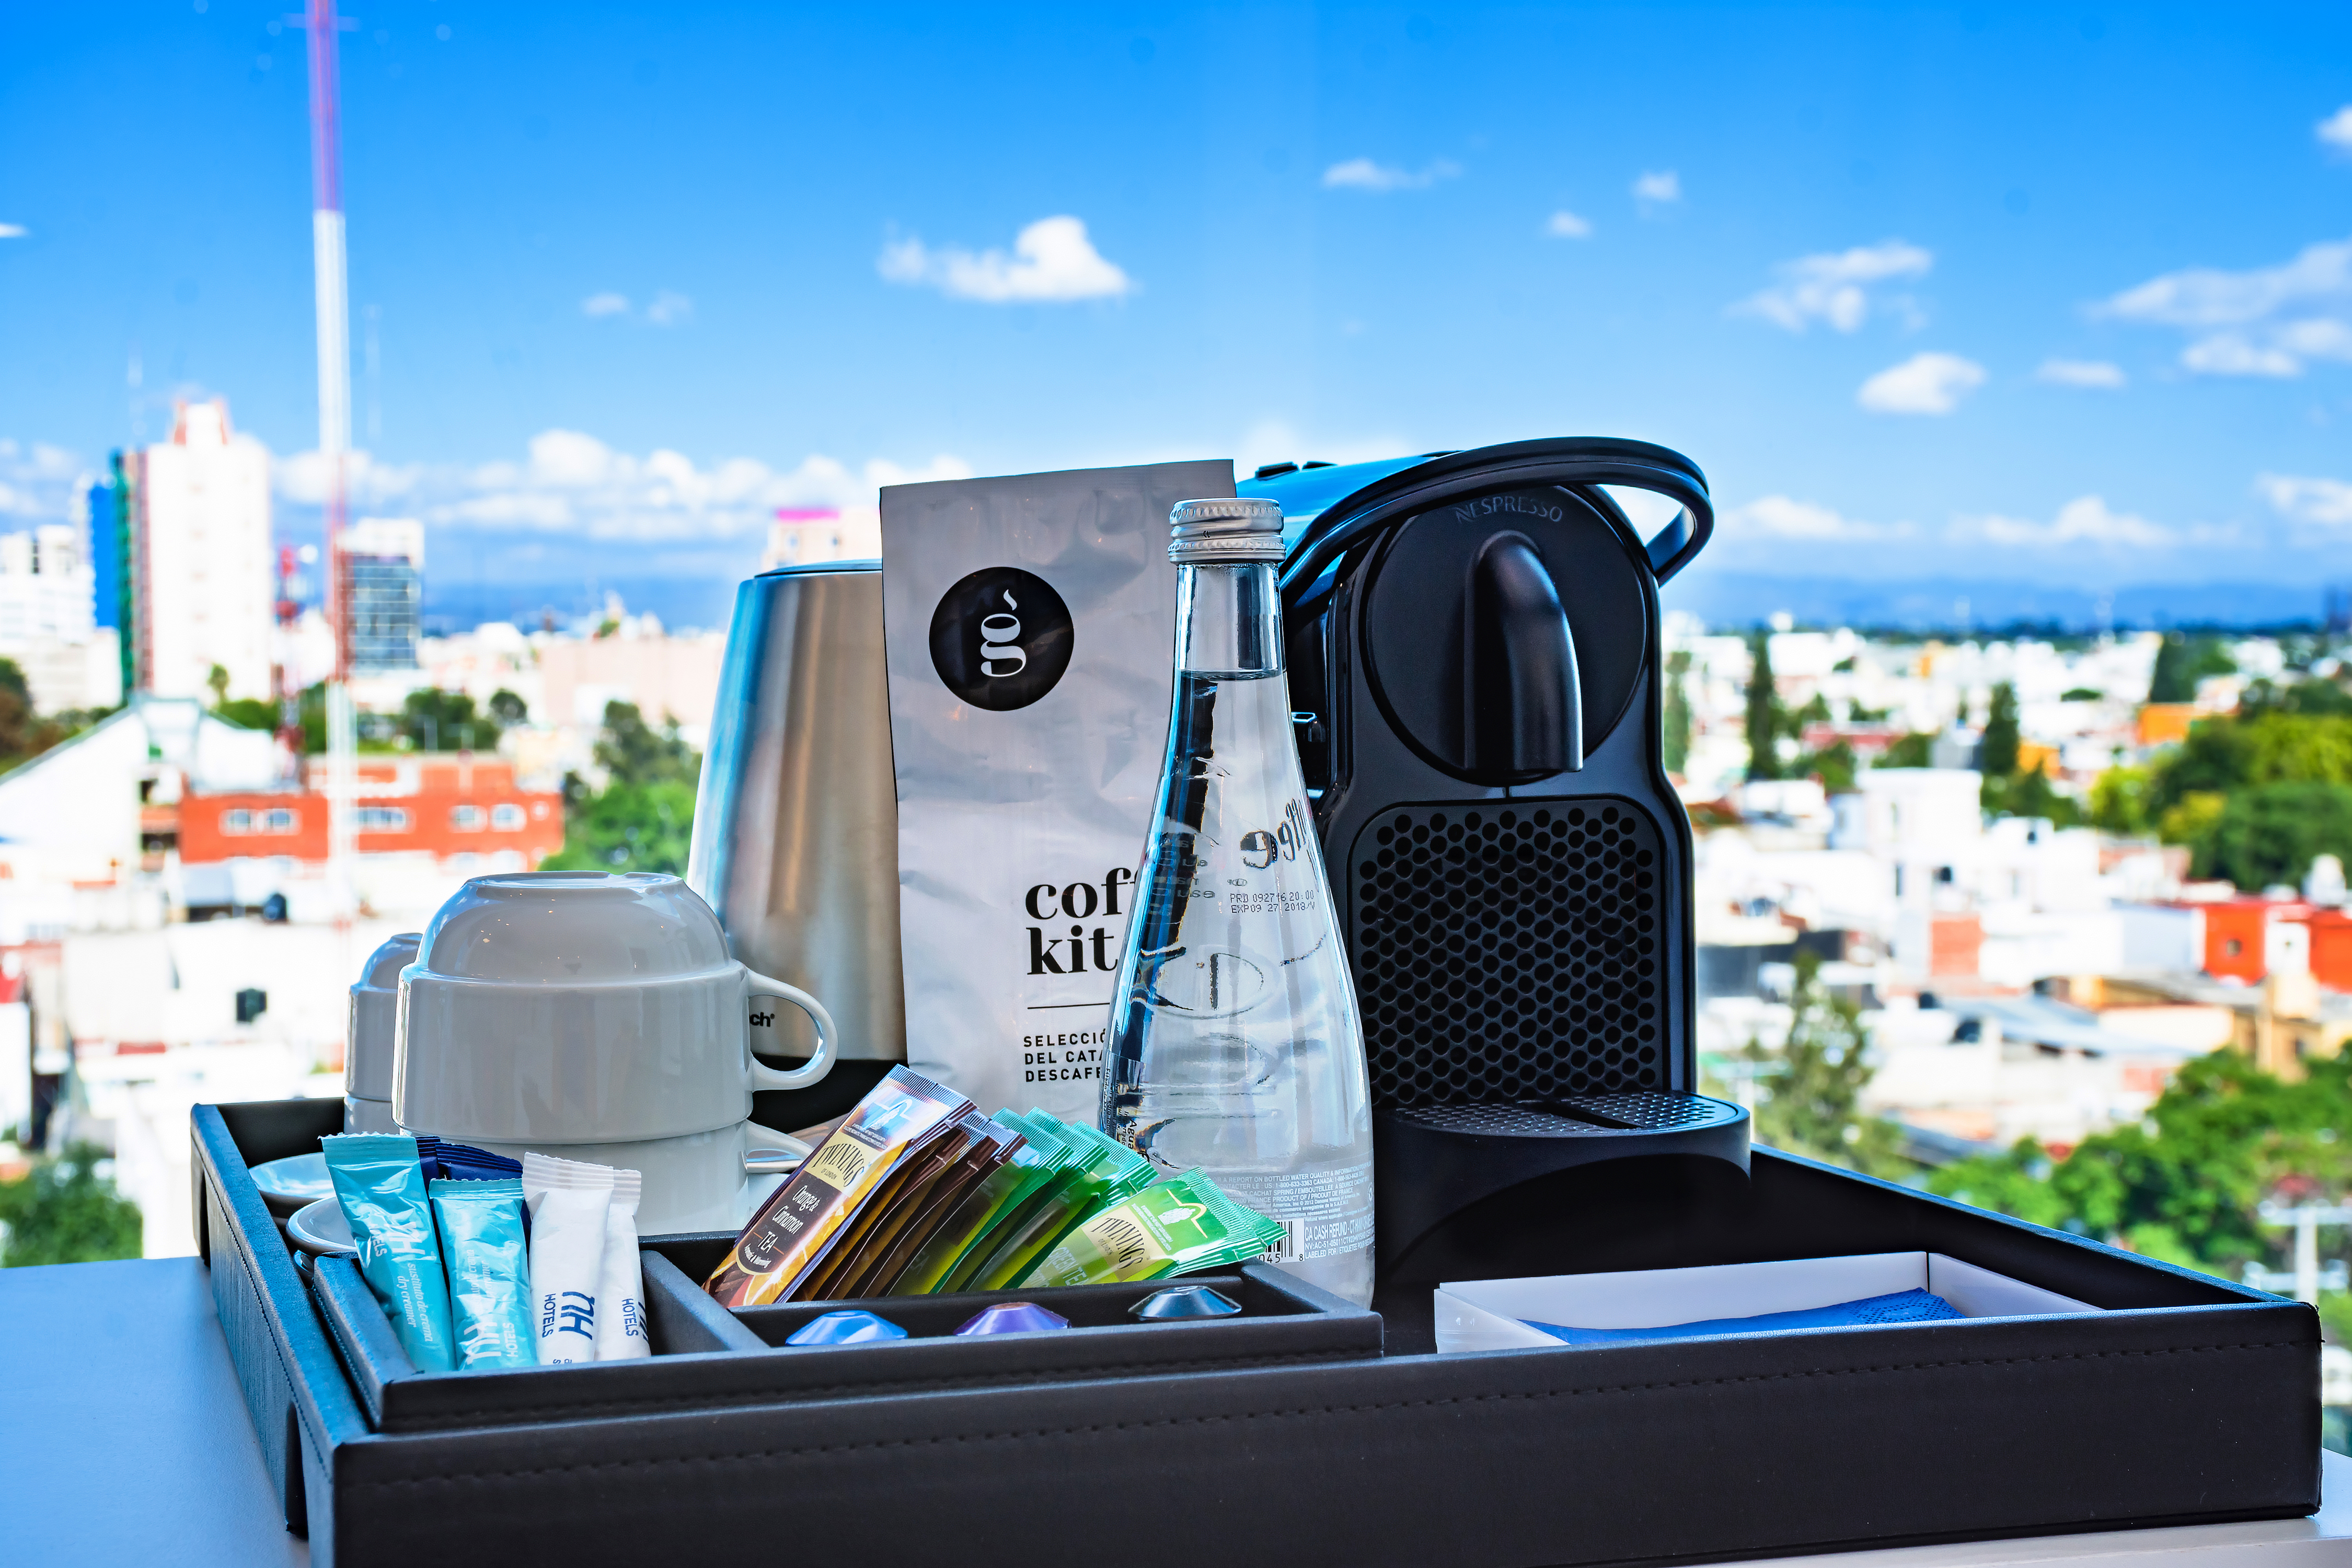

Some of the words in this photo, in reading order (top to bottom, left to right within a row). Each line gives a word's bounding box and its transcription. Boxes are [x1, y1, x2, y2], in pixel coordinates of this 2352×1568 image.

[1454, 494, 1563, 523] NESPRESSO
[1025, 867, 1138, 920] cof
[1230, 893, 1249, 903] PRD
[1289, 890, 1314, 902] 20:00
[1025, 924, 1118, 975] kit
[1024, 1052, 1057, 1065] DEL
[1127, 1119, 1137, 1150] Agua
[811, 1143, 864, 1187] TWININGS
[1311, 1191, 1332, 1199] PRODUIT
[771, 1205, 804, 1235] Cinnamon
[1305, 1226, 1313, 1242] CA
[1313, 1225, 1329, 1241] CASH
[1329, 1221, 1347, 1238] REFUND
[757, 1231, 779, 1254] TEA
[1090, 1217, 1145, 1270] TWININGS
[1305, 1249, 1327, 1260] LABELED
[1328, 1248, 1337, 1256] FOR
[1046, 1247, 1079, 1274] GREEN
[1299, 1253, 1304, 1262] 8
[397, 1275, 410, 1292] dry
[402, 1291, 417, 1328] creamer
[417, 1299, 429, 1313] de
[541, 1293, 557, 1338] HOTELS
[621, 1298, 639, 1337] HOTELS
[420, 1312, 433, 1342] crema
[502, 1322, 518, 1357] HOTELS
